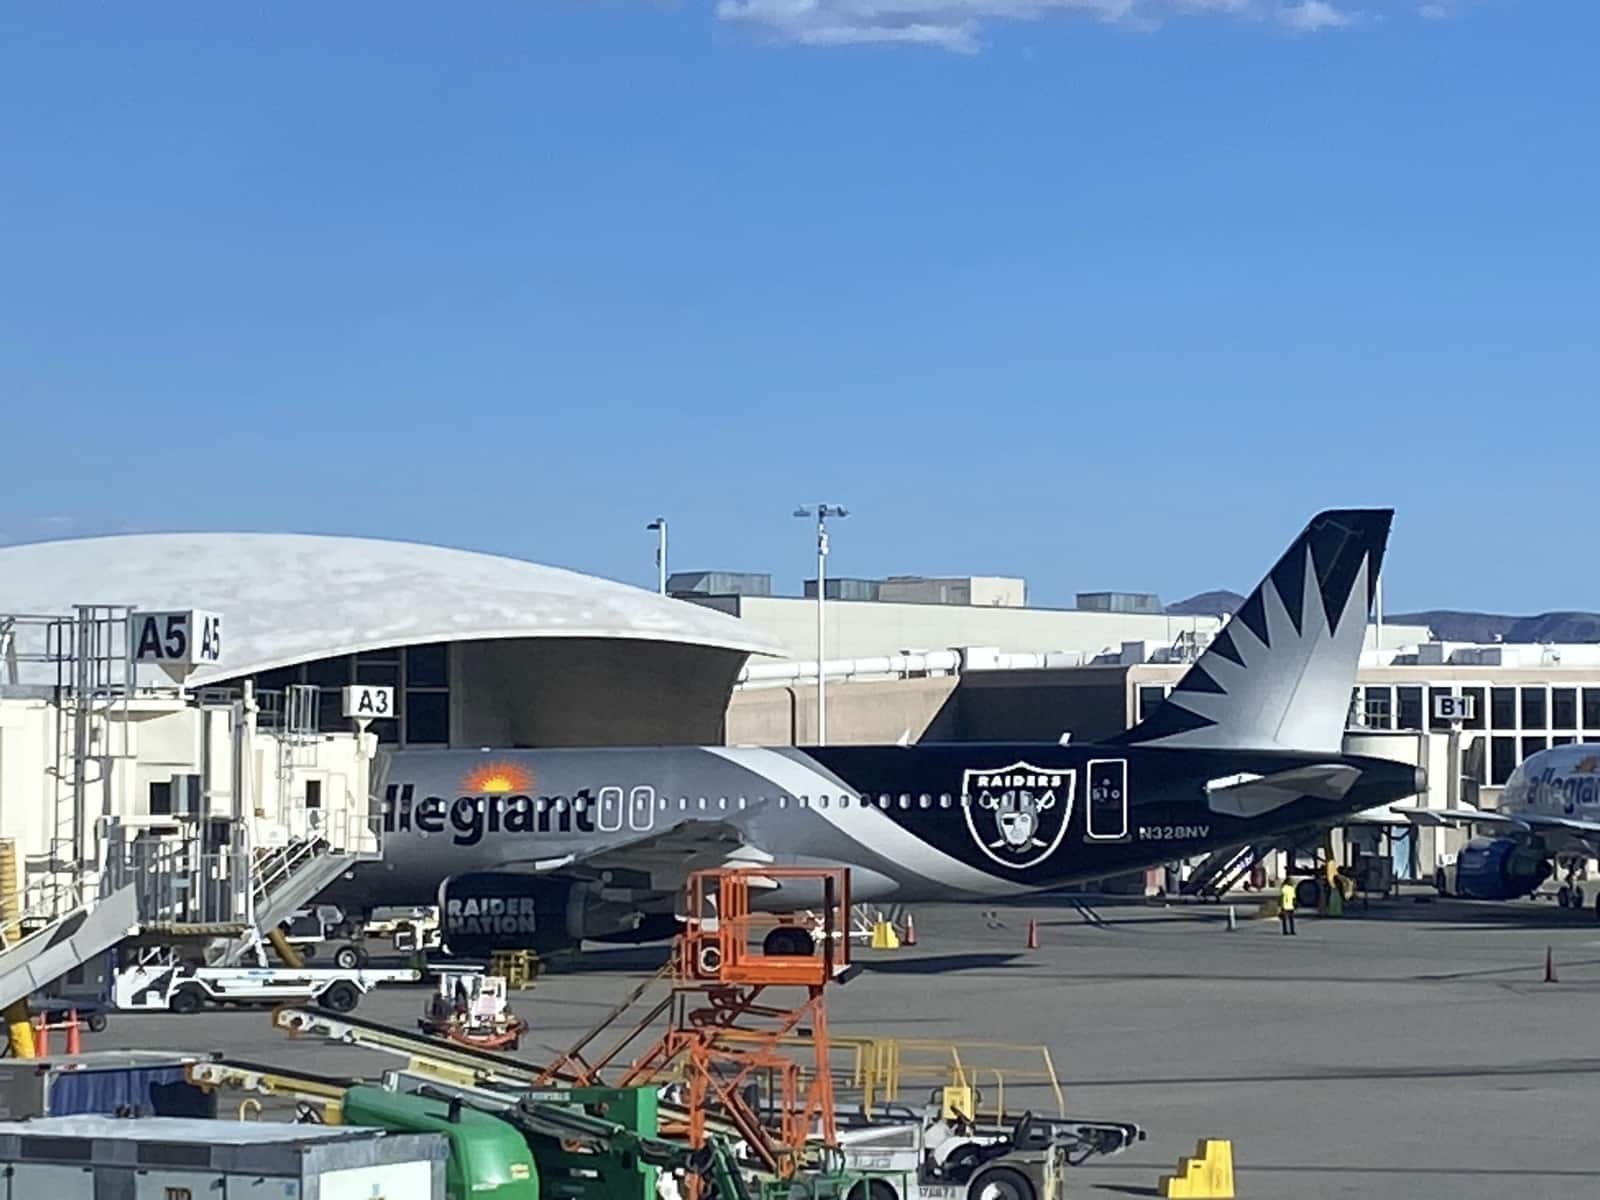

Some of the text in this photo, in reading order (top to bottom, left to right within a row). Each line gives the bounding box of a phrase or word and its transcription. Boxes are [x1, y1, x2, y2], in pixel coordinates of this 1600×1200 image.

[136, 615, 186, 659] A5
[200, 616, 220, 660] A5
[358, 689, 388, 714] A3
[1441, 698, 1466, 717] B1
[977, 775, 1062, 787] RAIDERS
[384, 784, 596, 846] llegiant
[1139, 826, 1209, 840] N328NV
[448, 898, 535, 916] RAIDER
[448, 916, 535, 934] NATION
